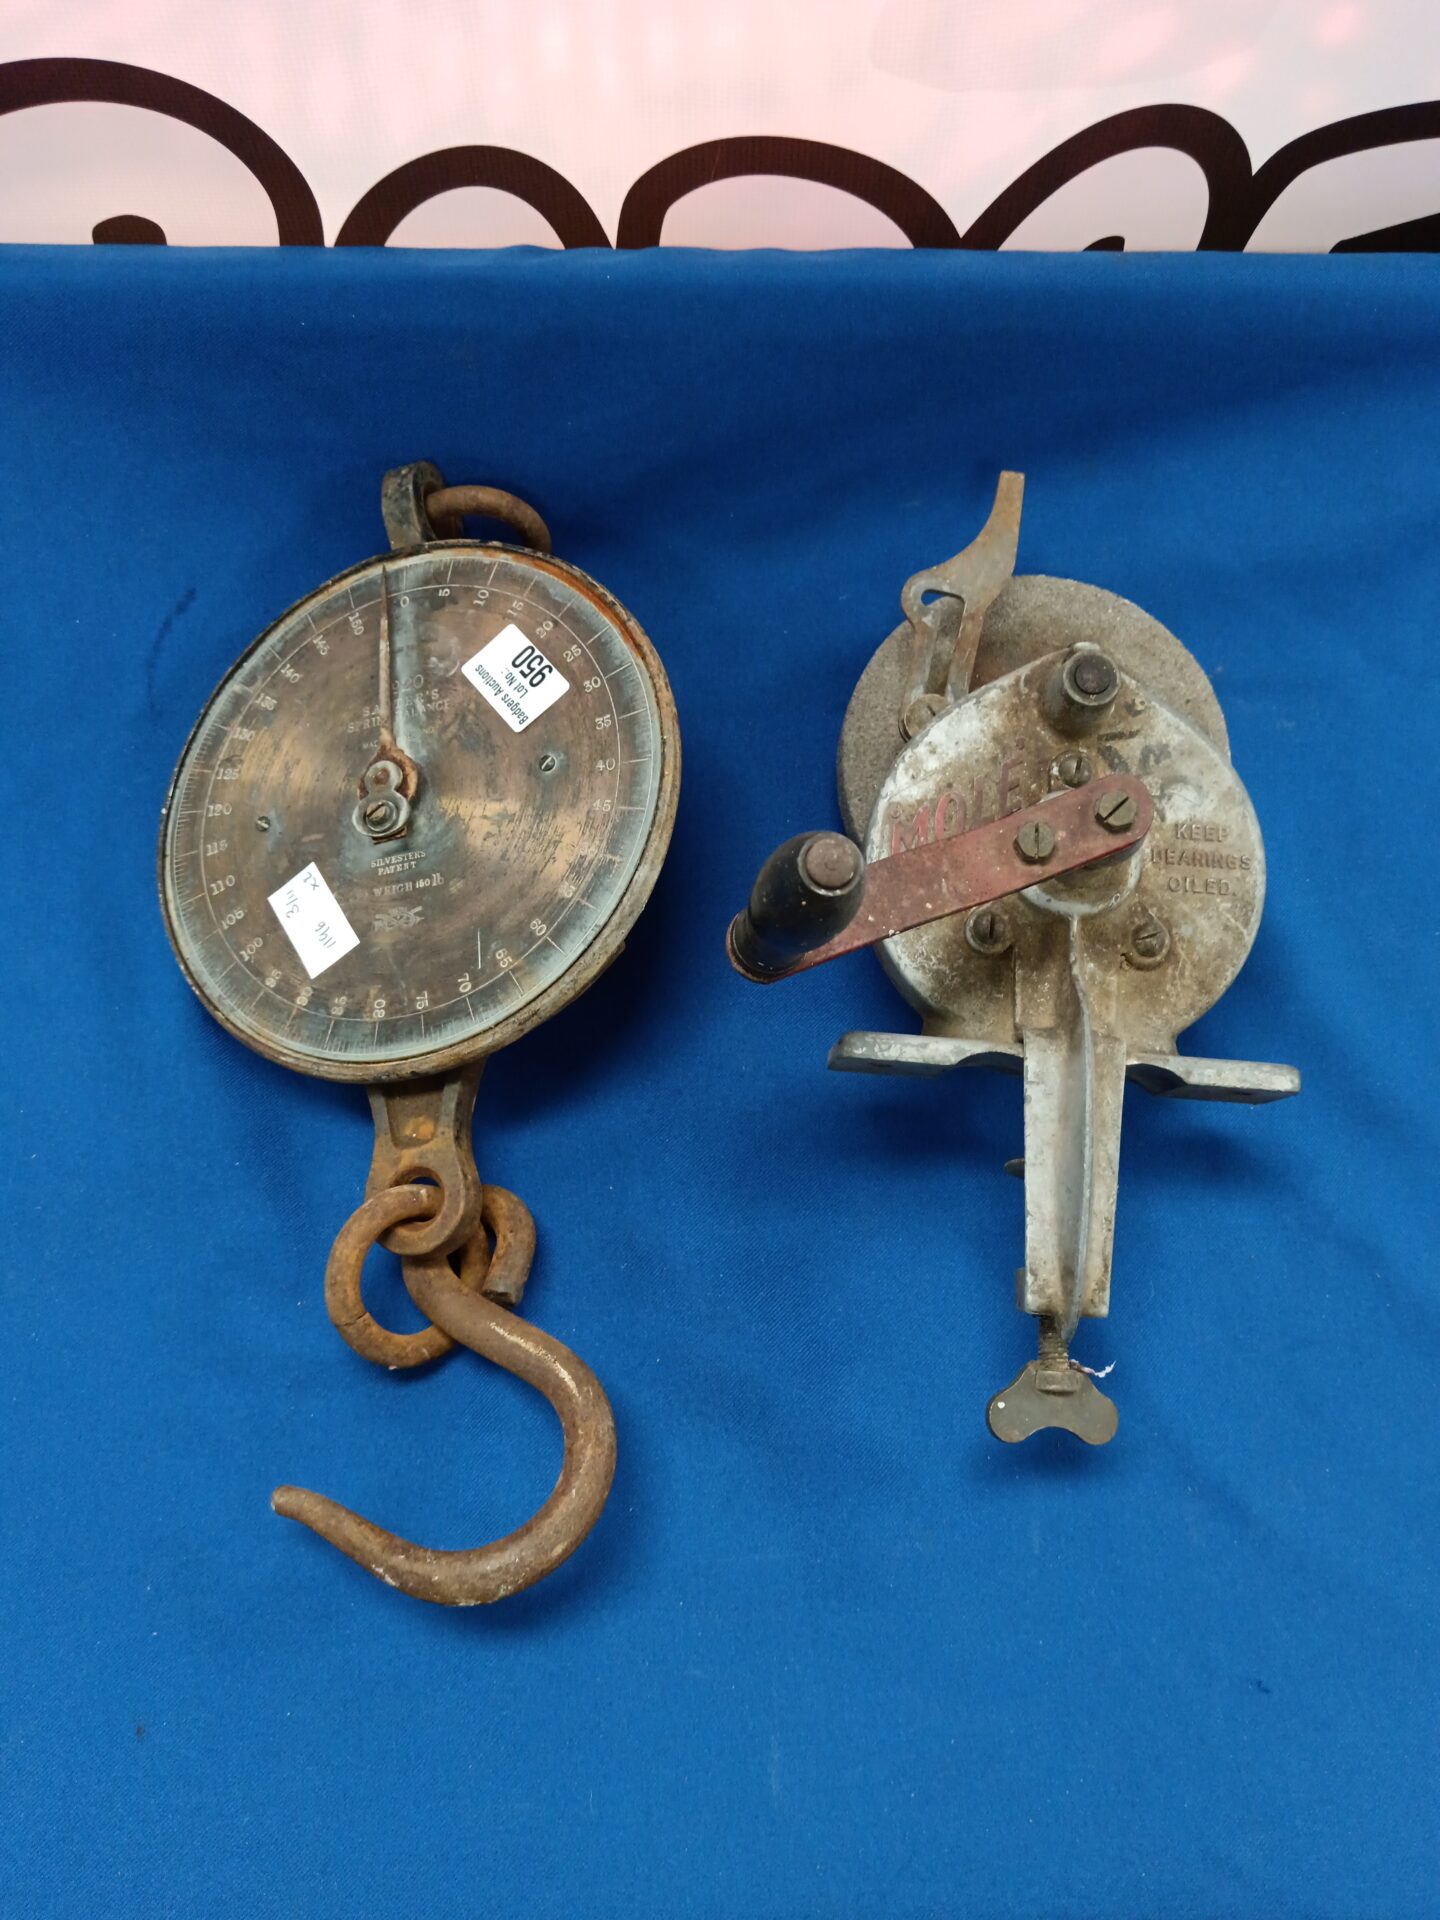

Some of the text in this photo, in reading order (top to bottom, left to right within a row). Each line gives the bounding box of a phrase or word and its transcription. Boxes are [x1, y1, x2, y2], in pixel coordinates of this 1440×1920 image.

[400, 595, 410, 608] 0
[438, 587, 450, 597] 5
[473, 589, 489, 607] 10
[506, 599, 524, 617] 15
[535, 619, 554, 639] 20
[562, 644, 582, 663] 25
[280, 663, 300, 683] 140
[511, 645, 553, 687] 950
[512, 682, 528, 699] Lot
[583, 676, 601, 693] 30
[475, 664, 529, 725] Badgers Auctions
[594, 714, 612, 730] 35
[595, 758, 616, 771] 40
[216, 768, 239, 781] 125
[207, 803, 232, 817] 120
[592, 799, 612, 812] 45
[1175, 822, 1230, 843] KEEP
[378, 861, 417, 876] PATENT
[1151, 848, 1252, 871] BEARINGS
[209, 874, 235, 896] 110
[432, 873, 445, 887] lb
[529, 918, 547, 937] 60
[239, 937, 264, 962] 100
[495, 948, 512, 968] 65
[265, 968, 282, 988] 95
[457, 972, 472, 993] 70
[296, 986, 313, 1006] 90
[330, 995, 347, 1016] 85
[415, 991, 429, 1010] 75
[373, 999, 387, 1018] 80
